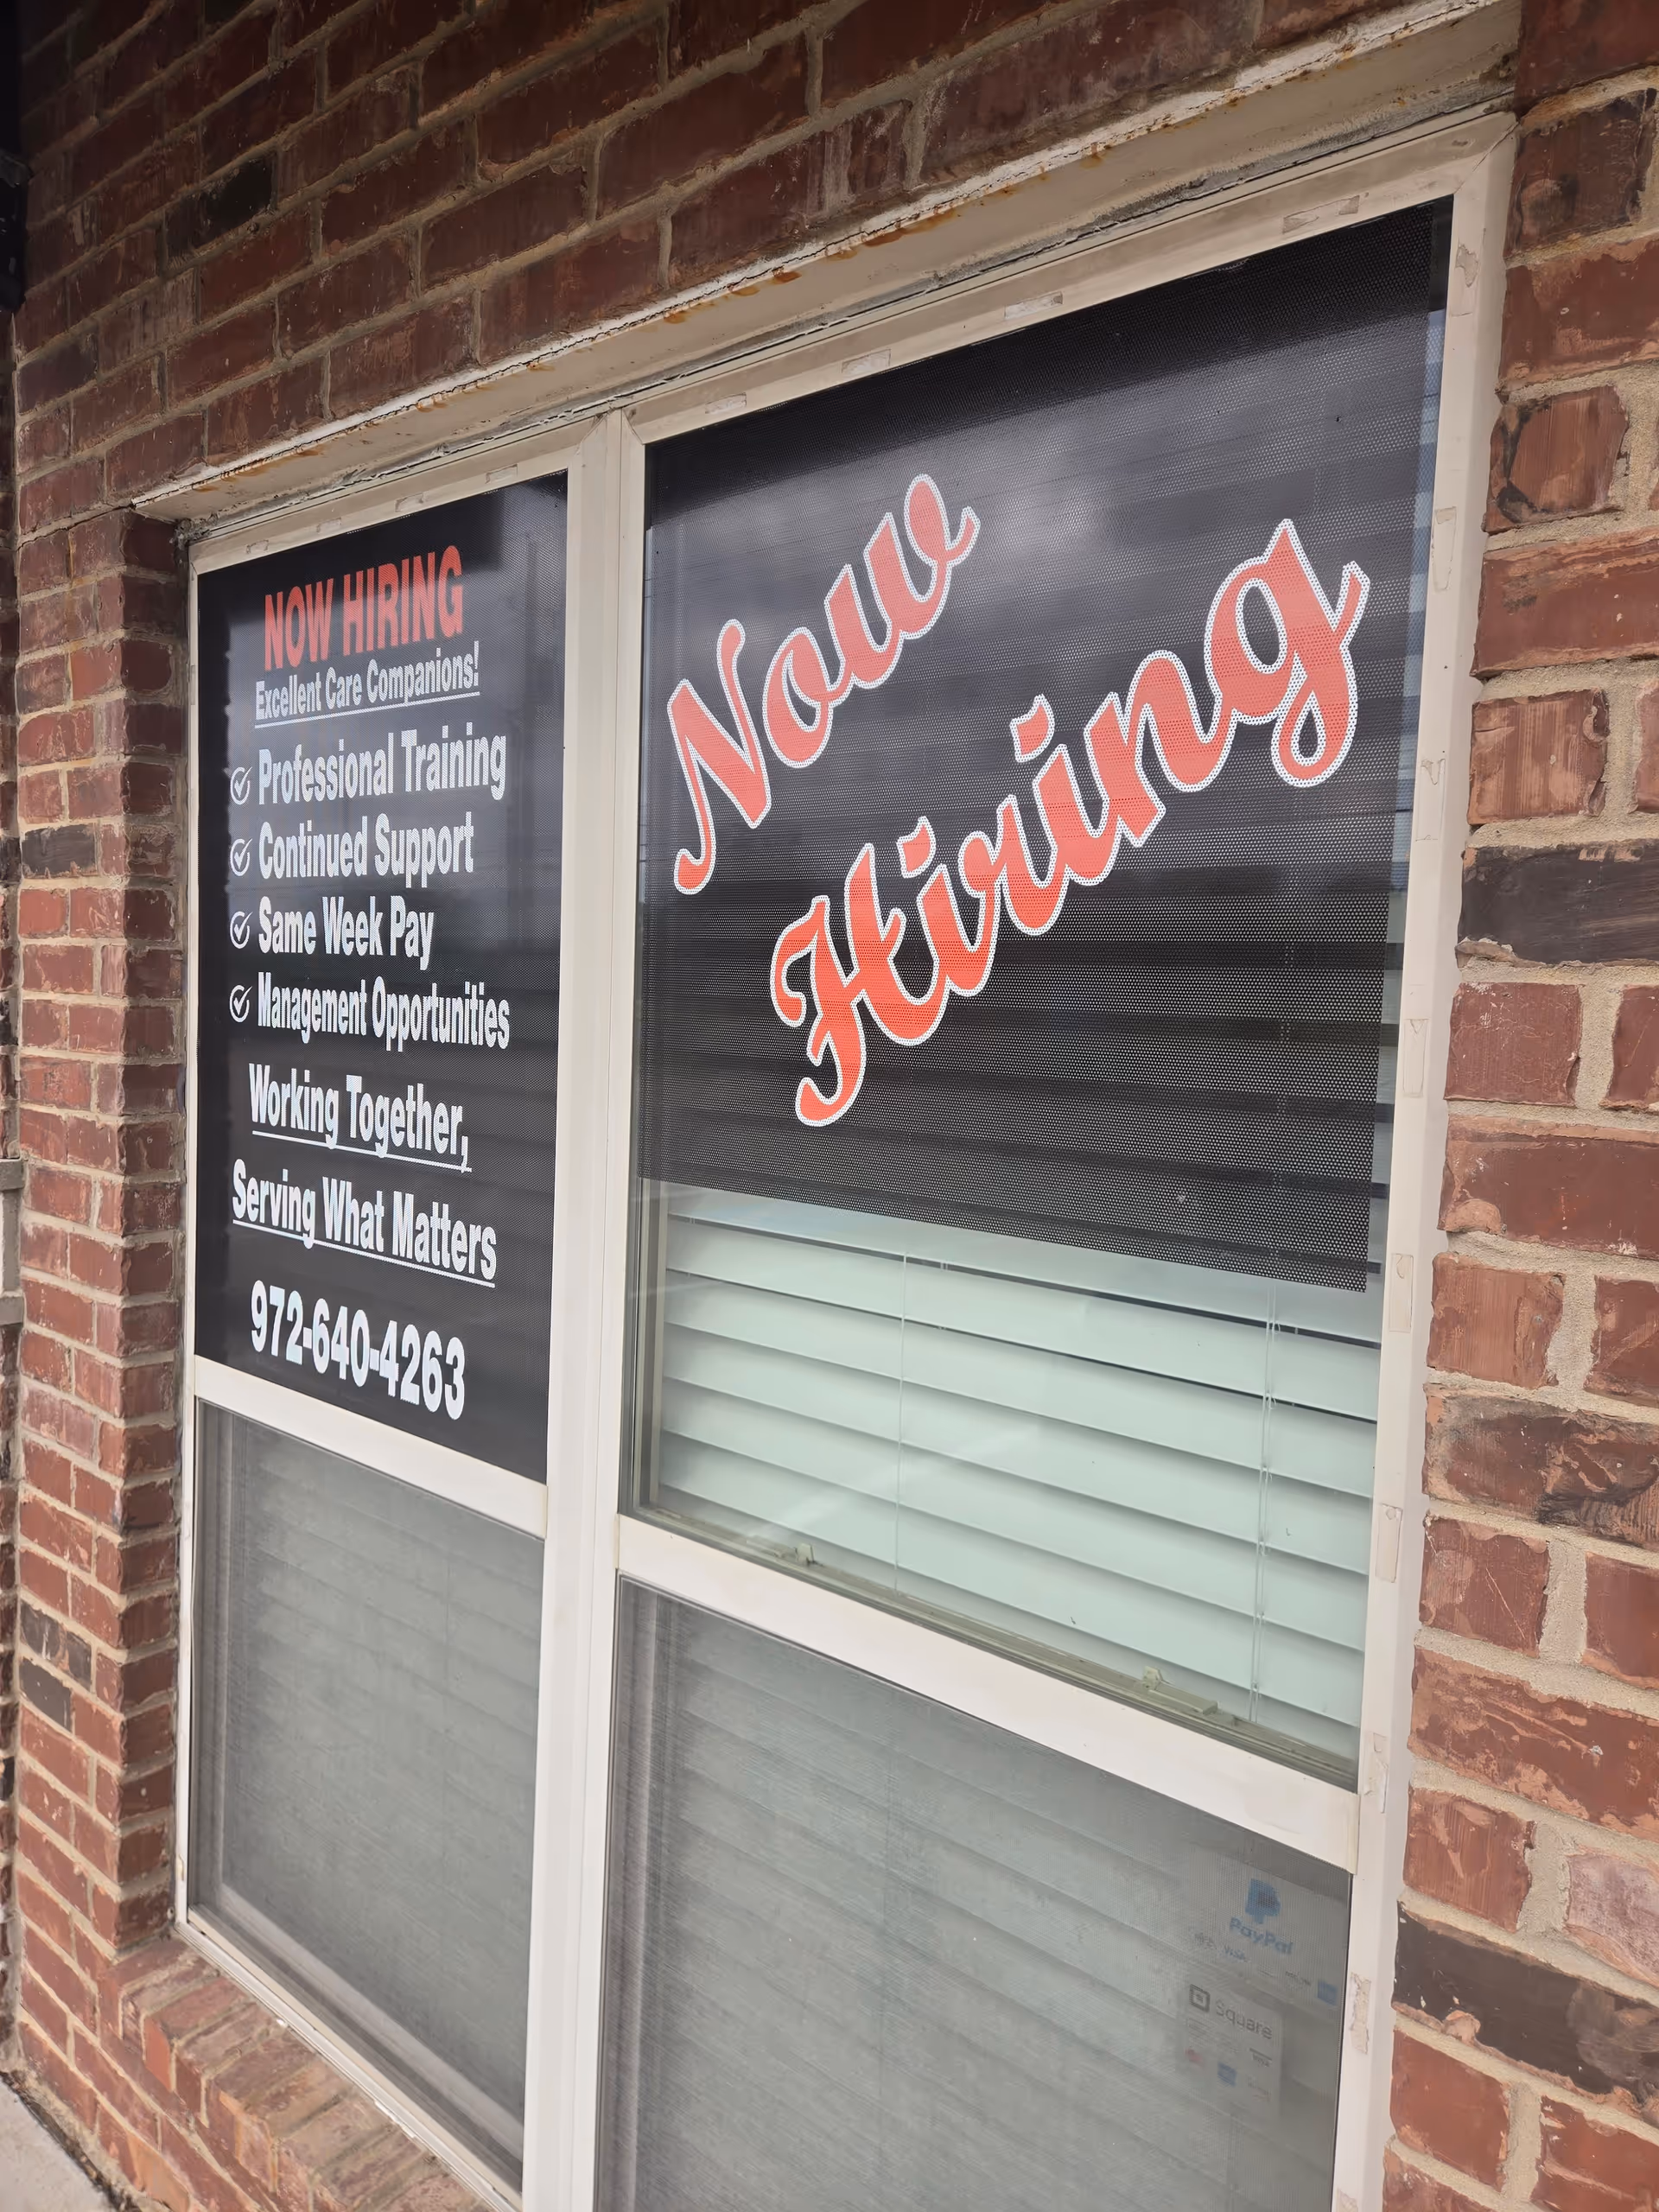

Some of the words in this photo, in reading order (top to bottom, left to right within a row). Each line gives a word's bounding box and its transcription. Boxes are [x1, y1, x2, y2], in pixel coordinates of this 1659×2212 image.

[264, 578, 334, 671] NOW
[343, 545, 463, 656] HIRING
[255, 672, 321, 721] Excellent
[325, 666, 362, 709] Care
[366, 640, 479, 706] Companions!
[666, 473, 980, 895] Now
[258, 732, 394, 804] Professional
[400, 721, 505, 800] Training
[258, 816, 367, 880] Continued
[374, 811, 474, 888] Support
[770, 518, 1371, 1126] Hiring
[258, 896, 316, 955] Same
[322, 896, 383, 957] Week
[390, 895, 434, 970] Pay
[257, 972, 367, 1044] Management
[372, 976, 510, 1052] Opportunities
[249, 1063, 339, 1149] Working
[346, 1075, 469, 1173] Together,
[232, 1159, 315, 1249] Serving
[322, 1177, 385, 1253] What
[392, 1191, 496, 1281] Matters
[251, 1280, 465, 1420] 972-640-4263
[1230, 1916, 1294, 1955] PayPal
[1215, 1998, 1273, 2040] Square
